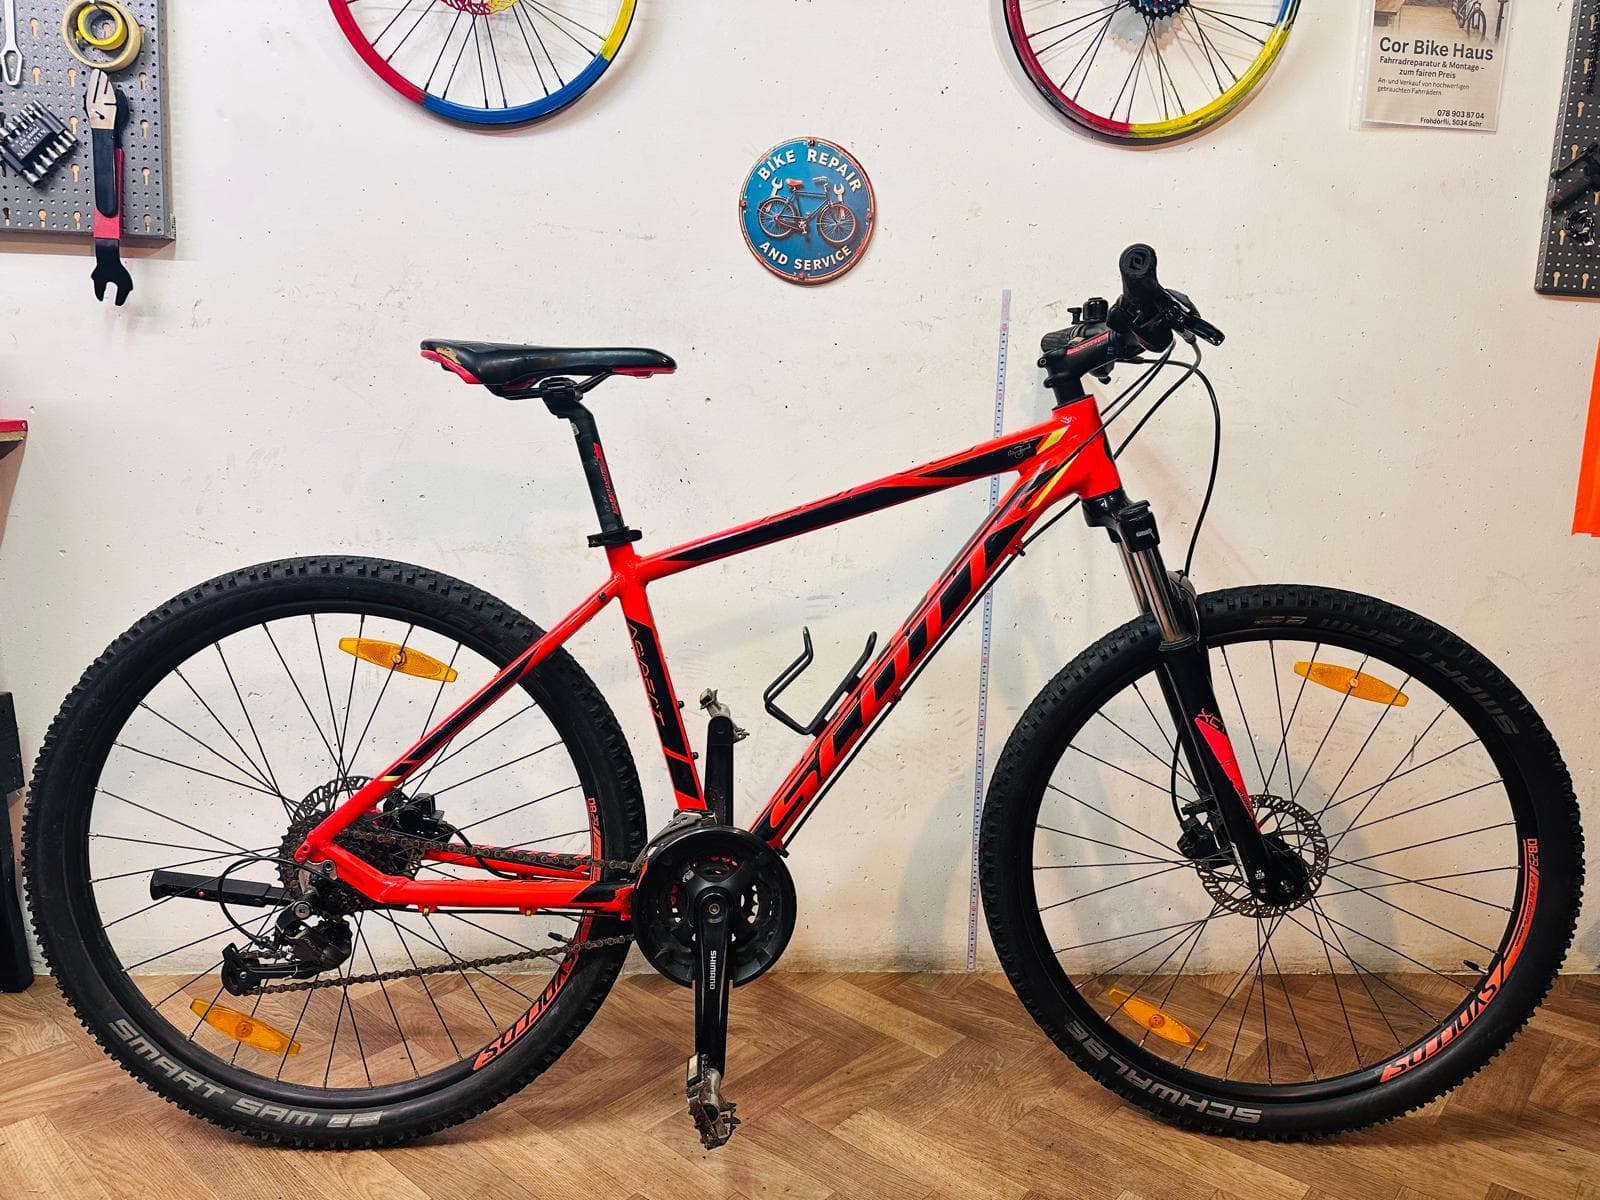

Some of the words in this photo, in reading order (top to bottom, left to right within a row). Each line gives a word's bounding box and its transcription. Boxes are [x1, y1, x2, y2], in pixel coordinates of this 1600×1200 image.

[1379, 37, 1409, 53] Cor
[1414, 40, 1448, 57] Bike
[1453, 43, 1494, 60] Haus
[1379, 56, 1440, 68] Fahrradreparatur
[1449, 61, 1480, 72] Montage
[1415, 69, 1437, 78] fairen
[1438, 70, 1456, 79] Preis
[1377, 85, 1411, 94] gebrauchten
[1412, 87, 1442, 96] Fahrrädern
[1400, 79, 1422, 87] Verkauf
[1433, 81, 1470, 91] hochwertigen
[1437, 109, 1450, 117] 078
[1452, 110, 1465, 118] 903
[757, 149, 796, 181] BIKE
[807, 148, 862, 192] REPAIR
[759, 241, 789, 265] AND
[793, 245, 852, 270] SERVICE
[769, 518, 1022, 829] SCOTT
[708, 949, 717, 991] SHIMANO
[107, 1018, 226, 1099] SMART
[231, 1098, 321, 1127] SAM
[1064, 1019, 1264, 1125] SCHWALBE
